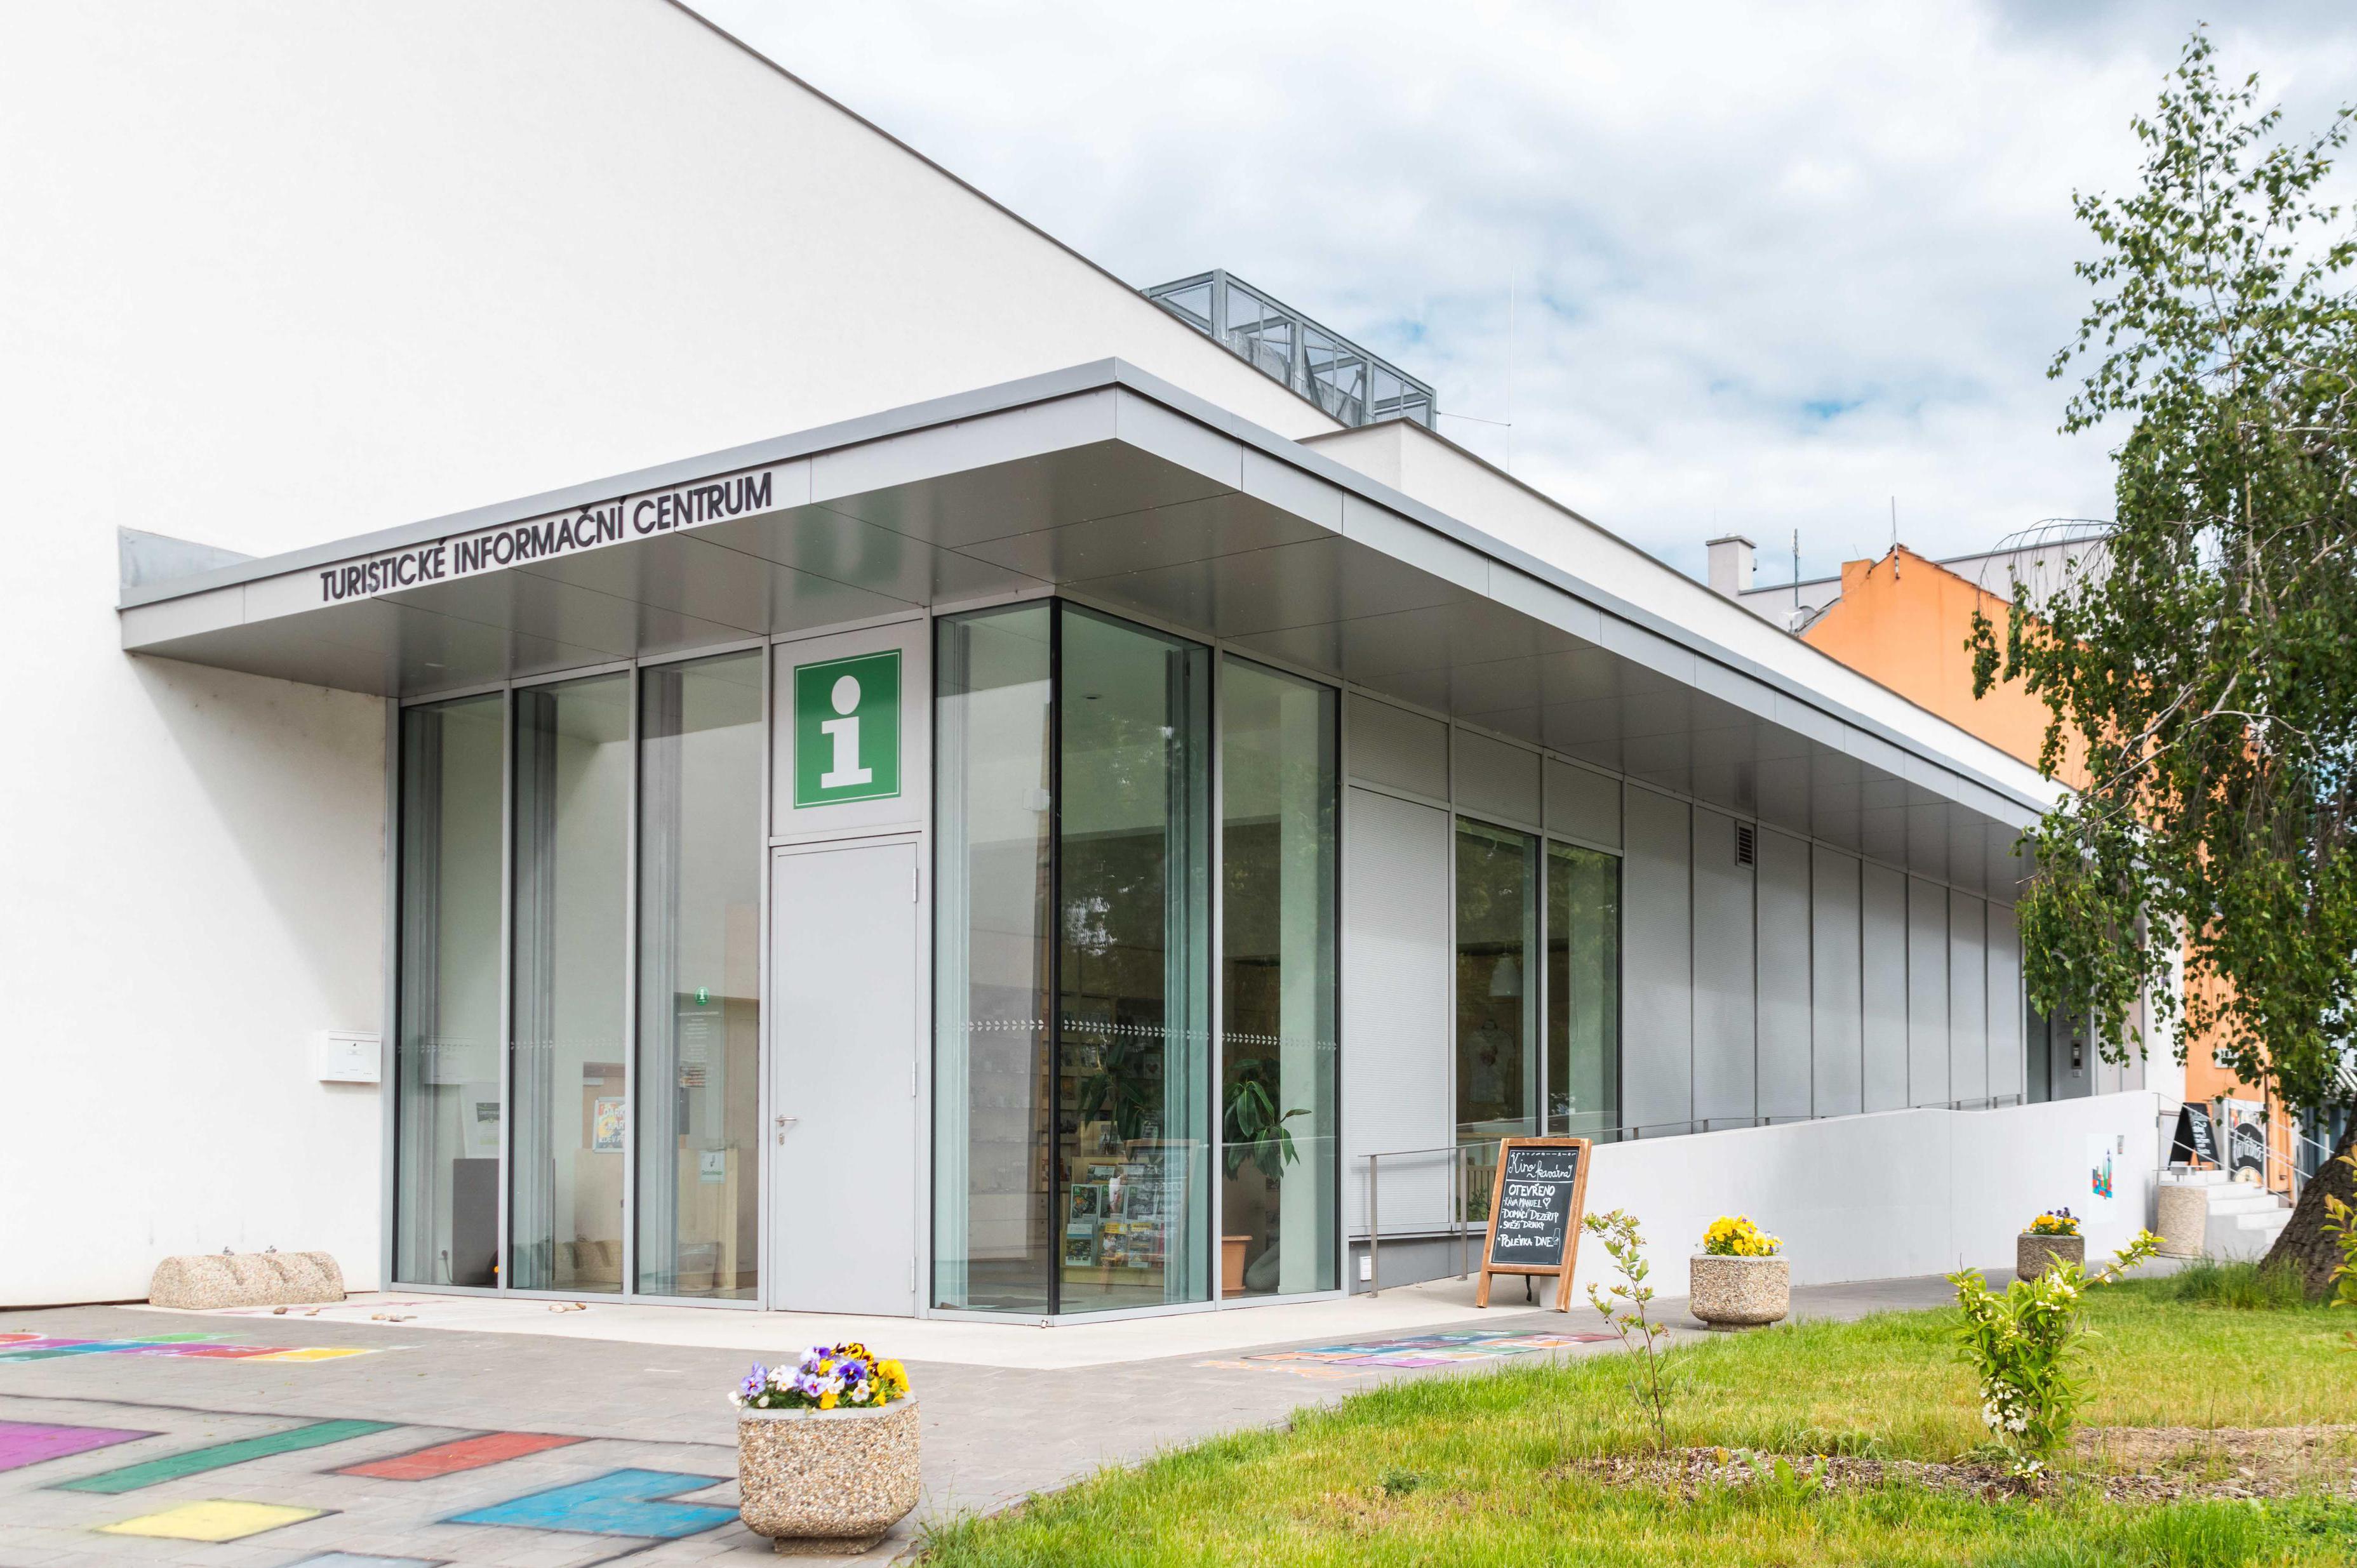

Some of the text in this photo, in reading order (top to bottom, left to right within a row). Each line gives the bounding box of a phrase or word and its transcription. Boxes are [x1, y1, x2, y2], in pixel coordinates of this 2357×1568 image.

[320, 472, 771, 602] TURISTICKÉ INFORMAČNÍ CENTRUM
[1508, 1153, 1573, 1181] Kino kavárna
[1509, 1183, 1555, 1197] OTEVŘENO
[1530, 1209, 1559, 1223] DEZERTY
[1521, 1220, 1544, 1230] DRINKY
[1533, 1236, 1554, 1247] DNE
